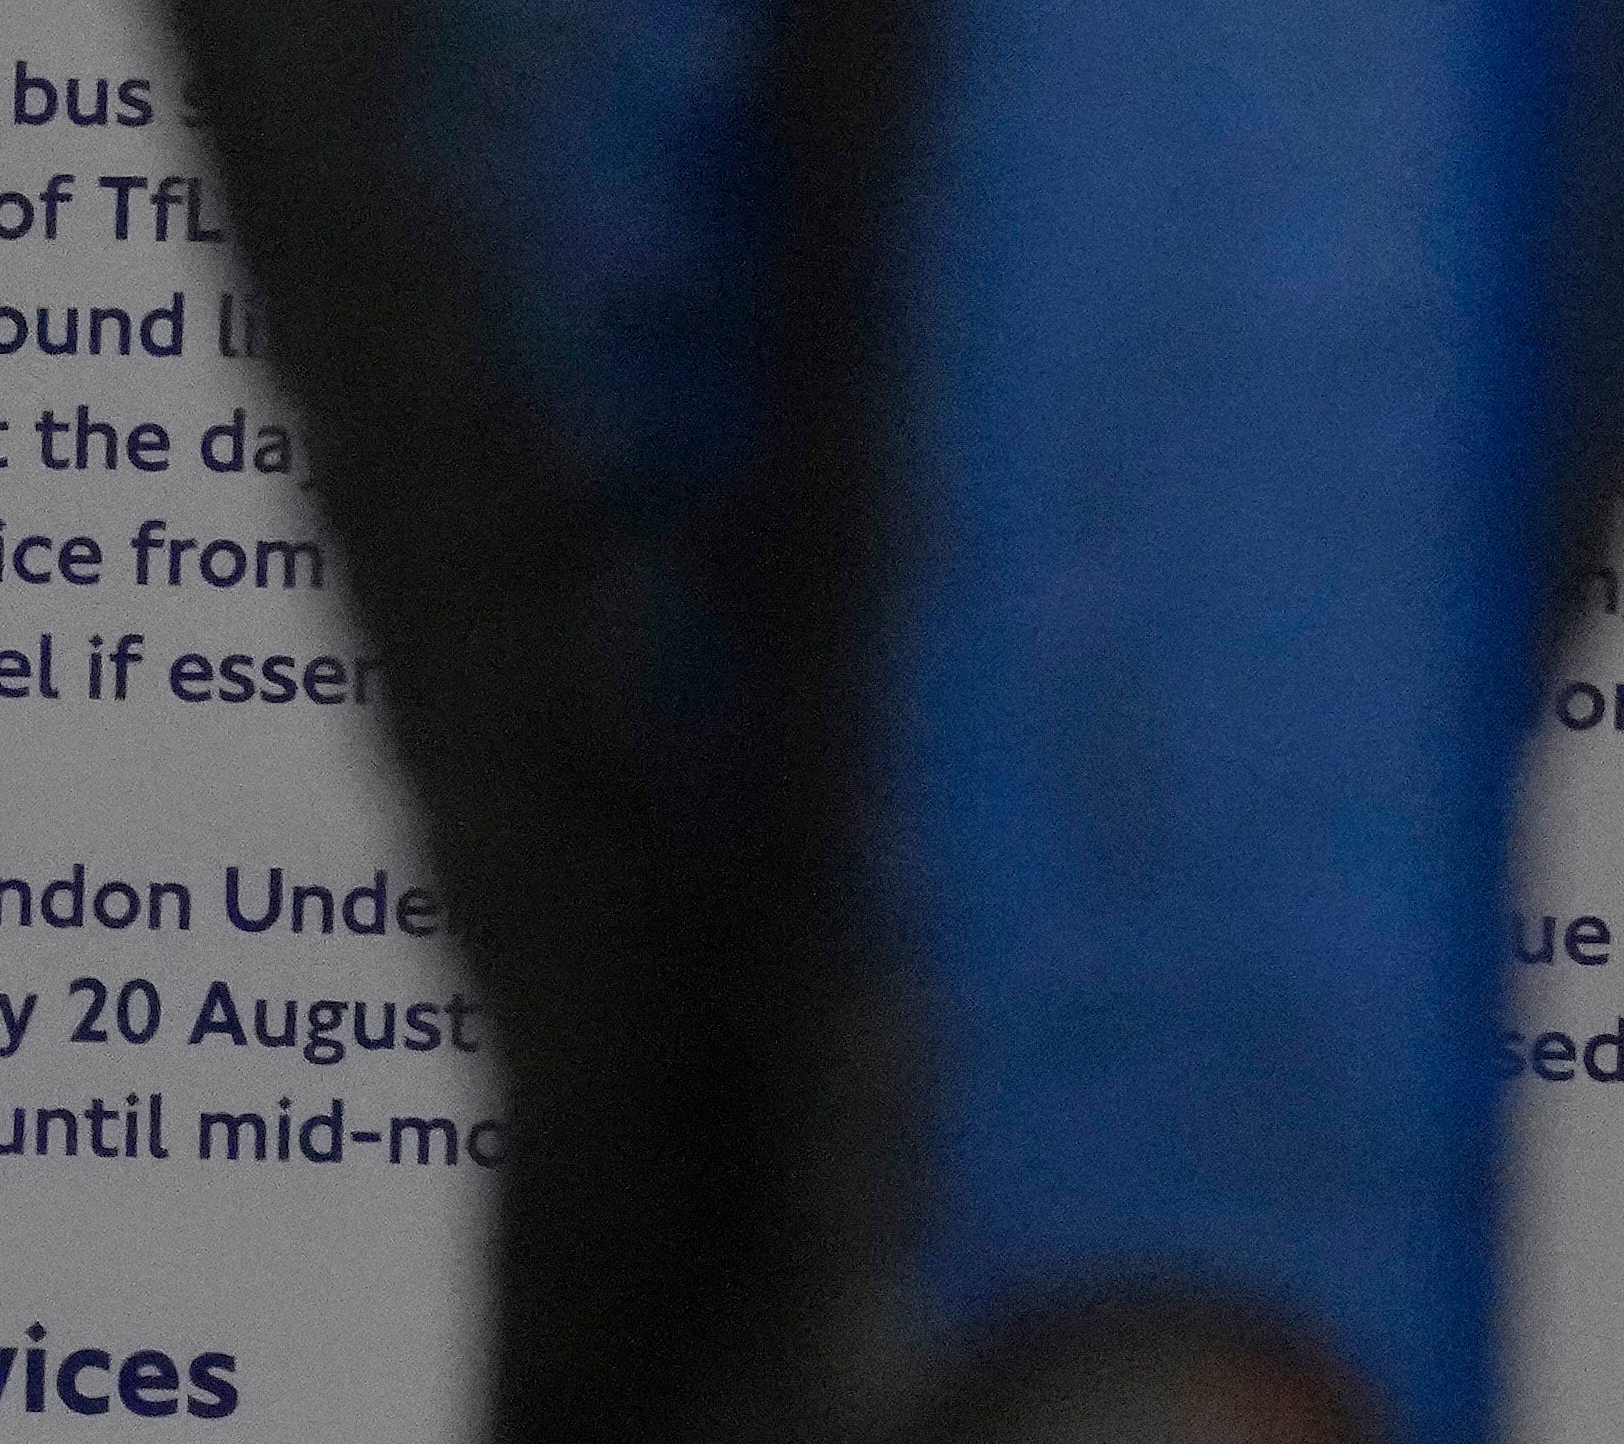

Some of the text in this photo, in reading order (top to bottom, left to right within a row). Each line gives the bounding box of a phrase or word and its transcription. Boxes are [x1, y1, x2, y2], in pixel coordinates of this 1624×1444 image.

[13, 60, 153, 128] bus
[98, 175, 225, 243] TfL
[34, 404, 171, 473] the
[200, 408, 311, 490] da
[130, 519, 324, 589] from
[88, 633, 144, 701] if
[69, 976, 161, 1045] 20
[188, 980, 478, 1066] August
